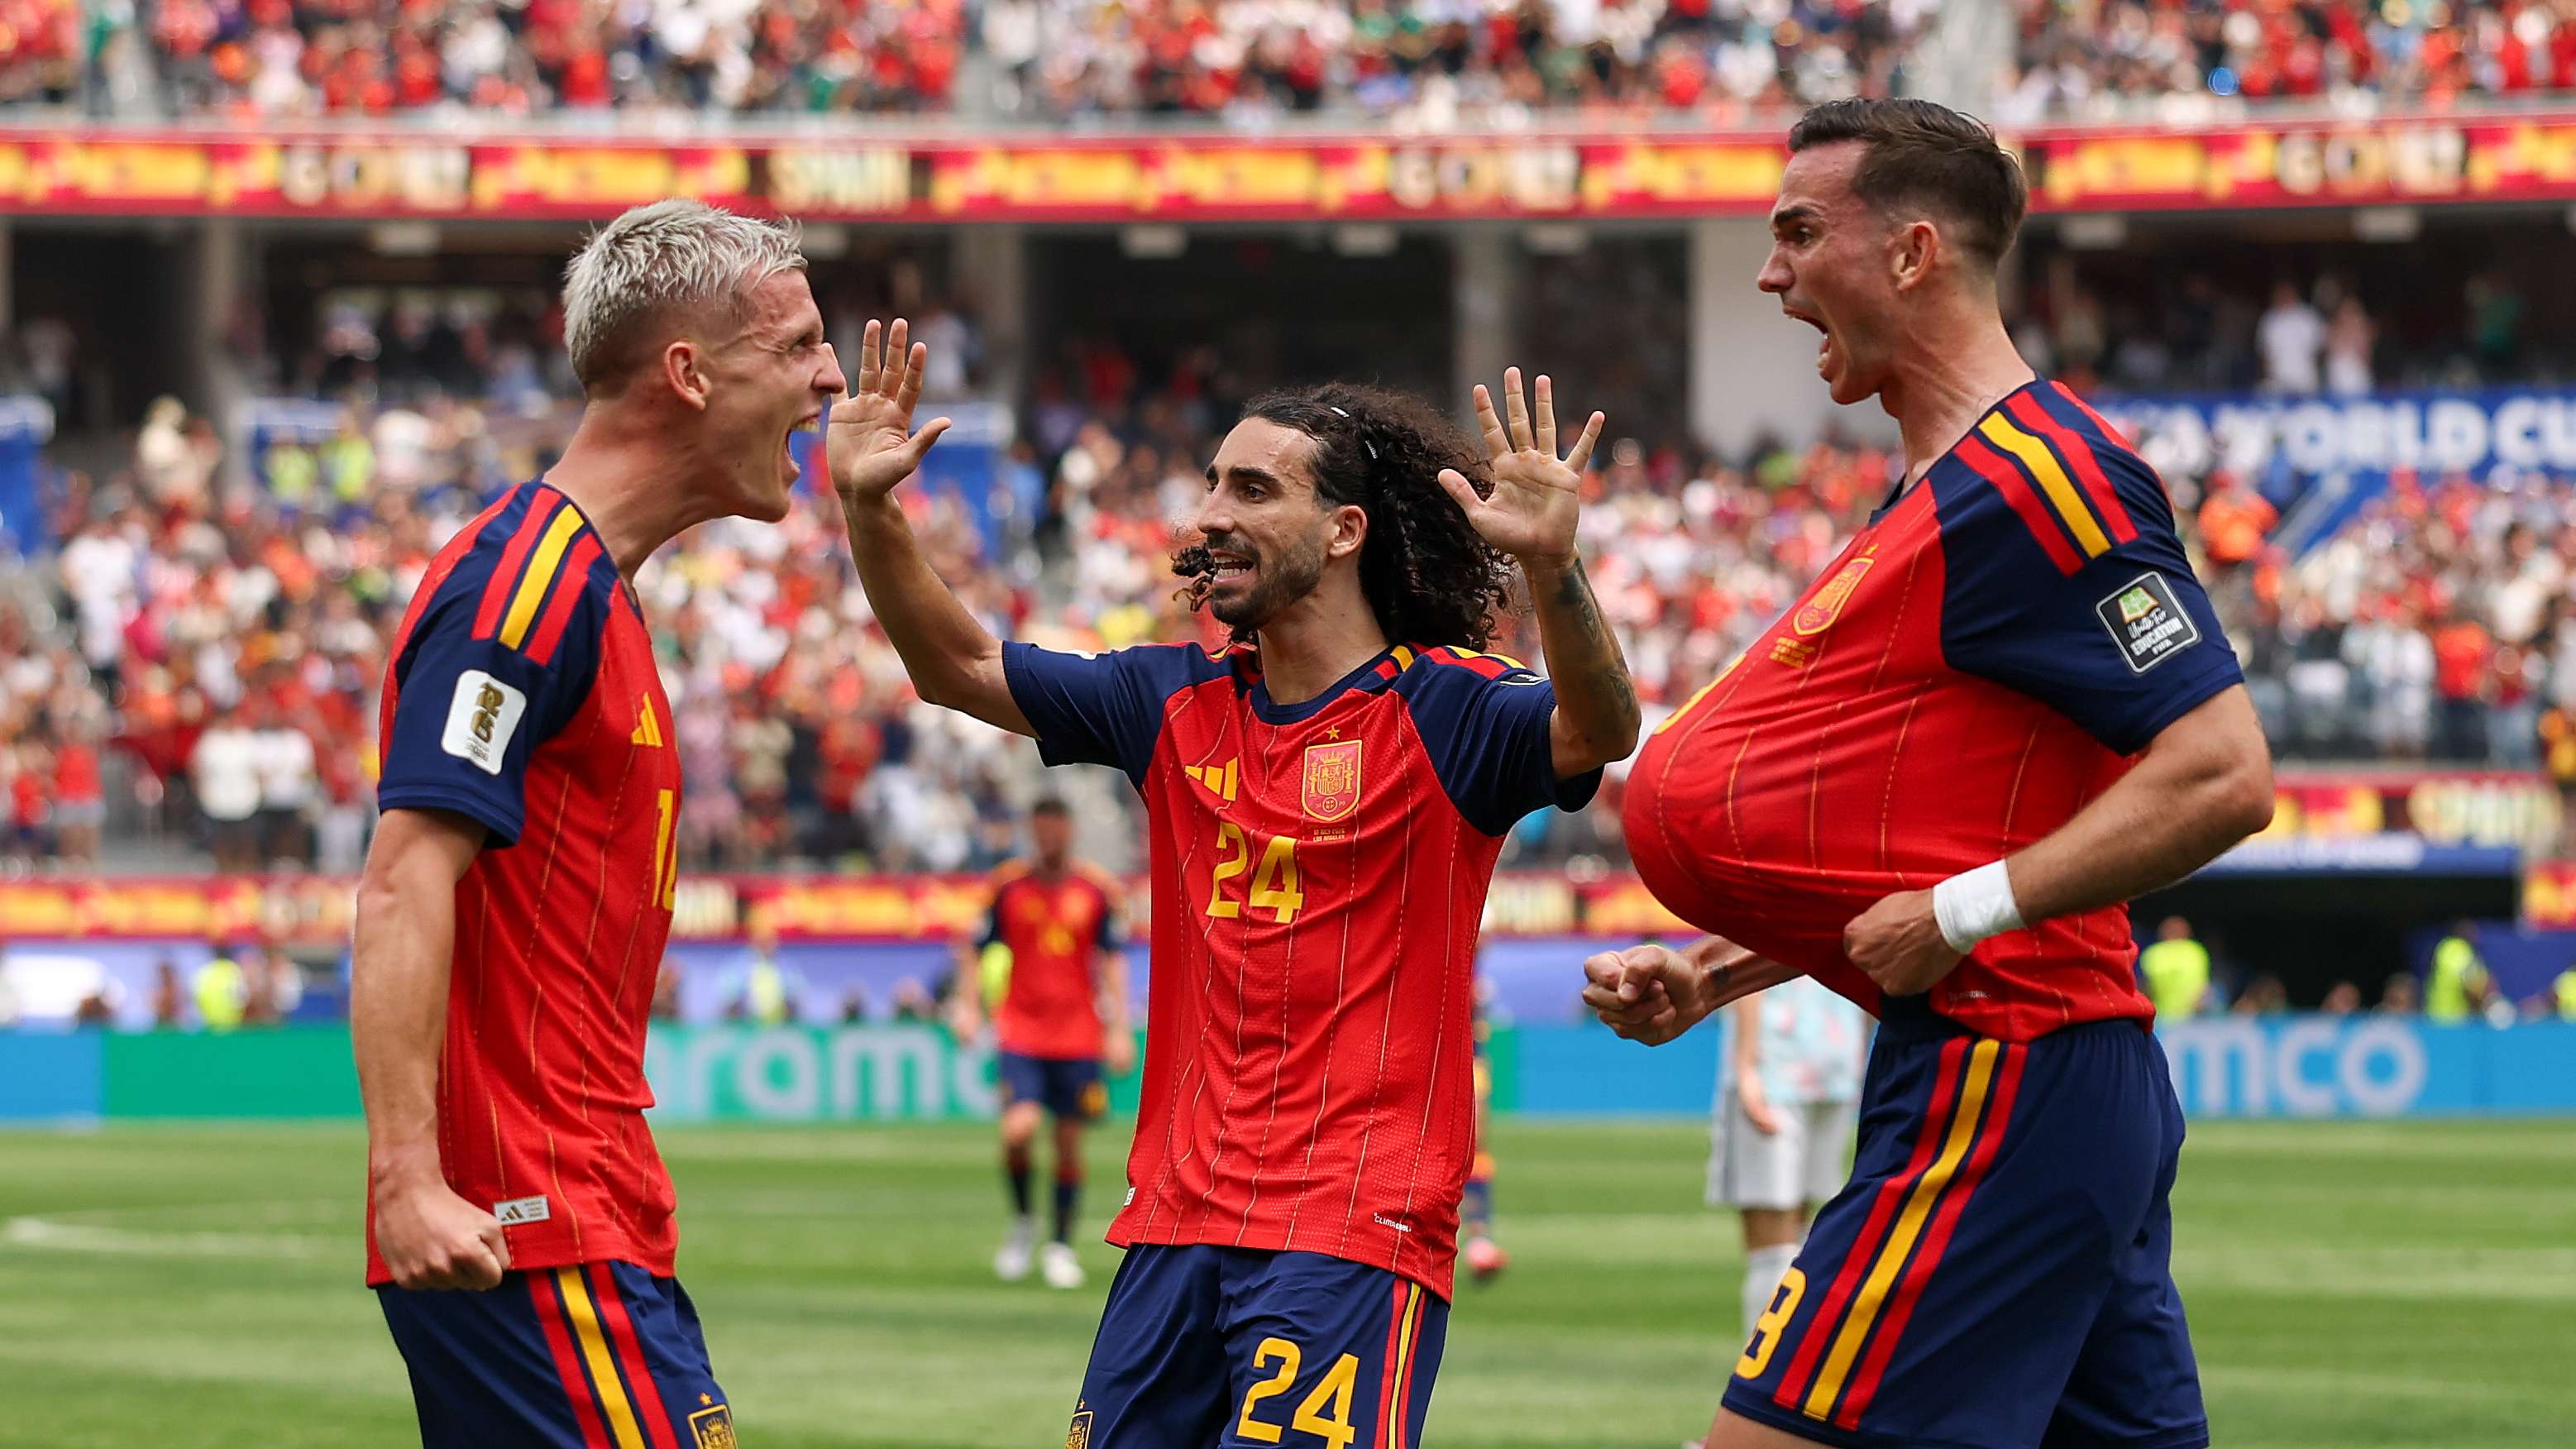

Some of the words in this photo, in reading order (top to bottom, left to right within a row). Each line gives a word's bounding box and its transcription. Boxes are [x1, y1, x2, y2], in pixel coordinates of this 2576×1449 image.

[1205, 821, 1303, 924] 24
[2163, 1021, 2426, 1116] mco
[1236, 1337, 1360, 1449] 24
